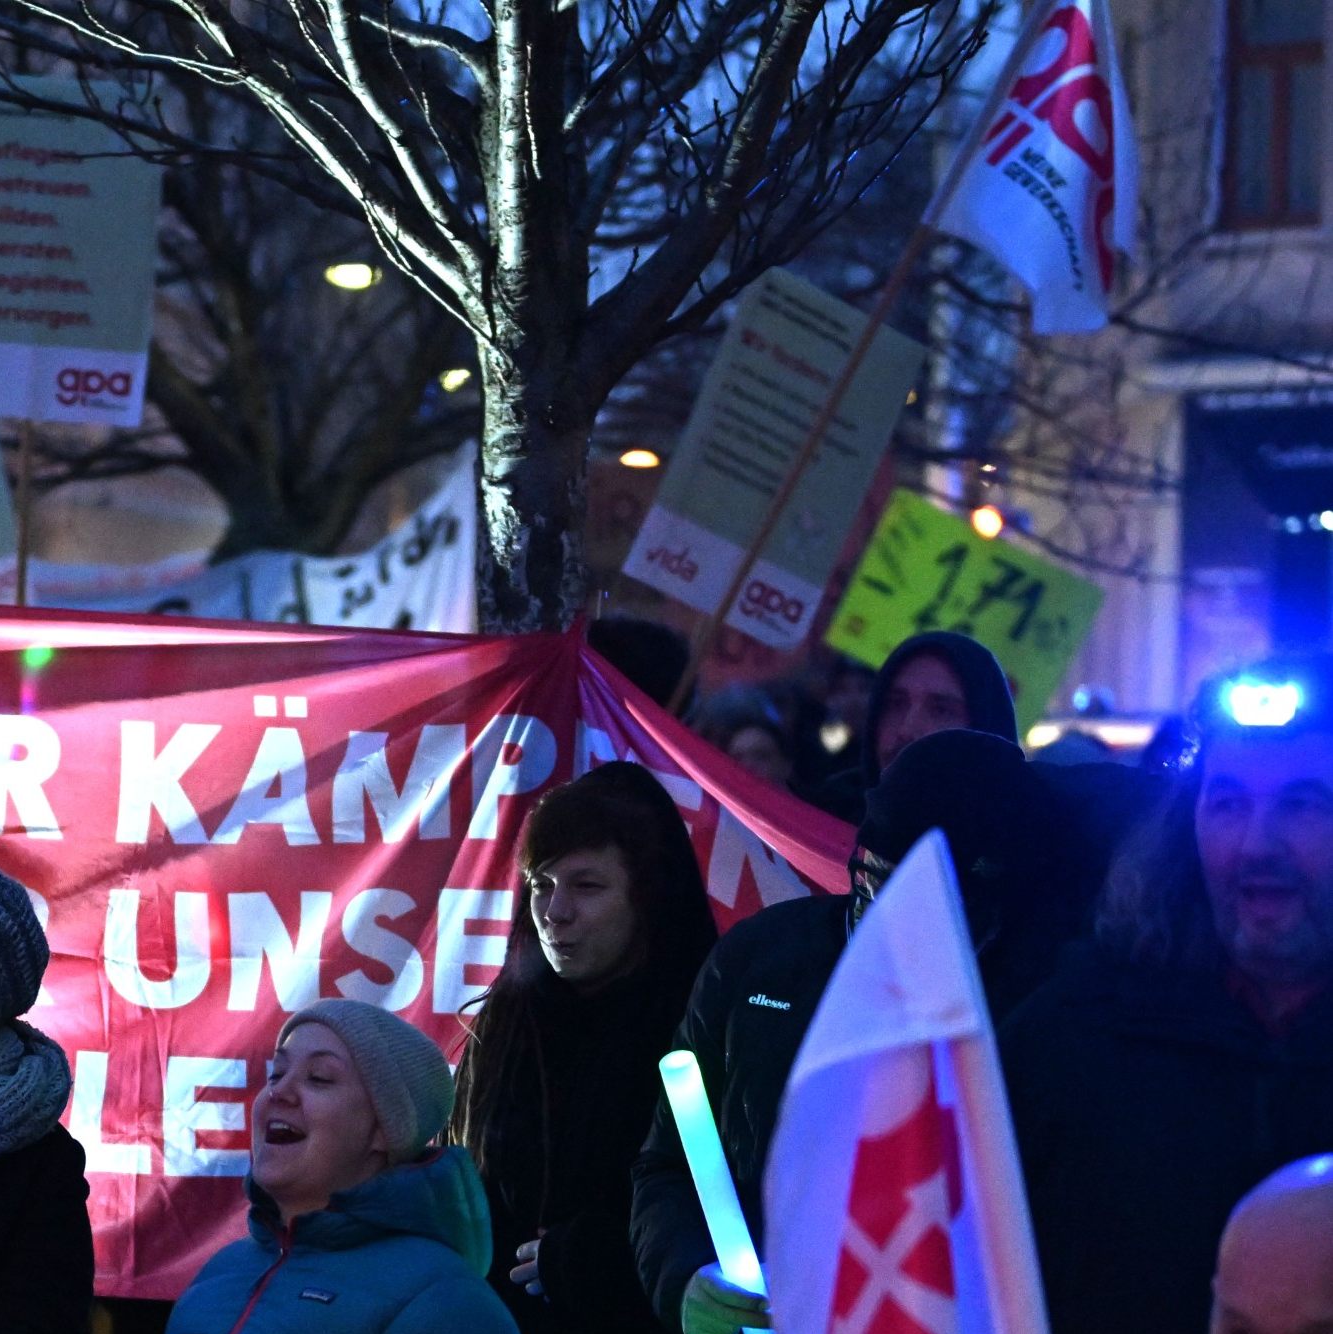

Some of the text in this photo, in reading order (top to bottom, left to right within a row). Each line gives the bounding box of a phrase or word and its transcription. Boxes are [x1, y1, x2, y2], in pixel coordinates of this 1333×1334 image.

[56, 368, 133, 406] gpa
[738, 580, 804, 625] gpa
[748, 993, 792, 1011] ellesse
